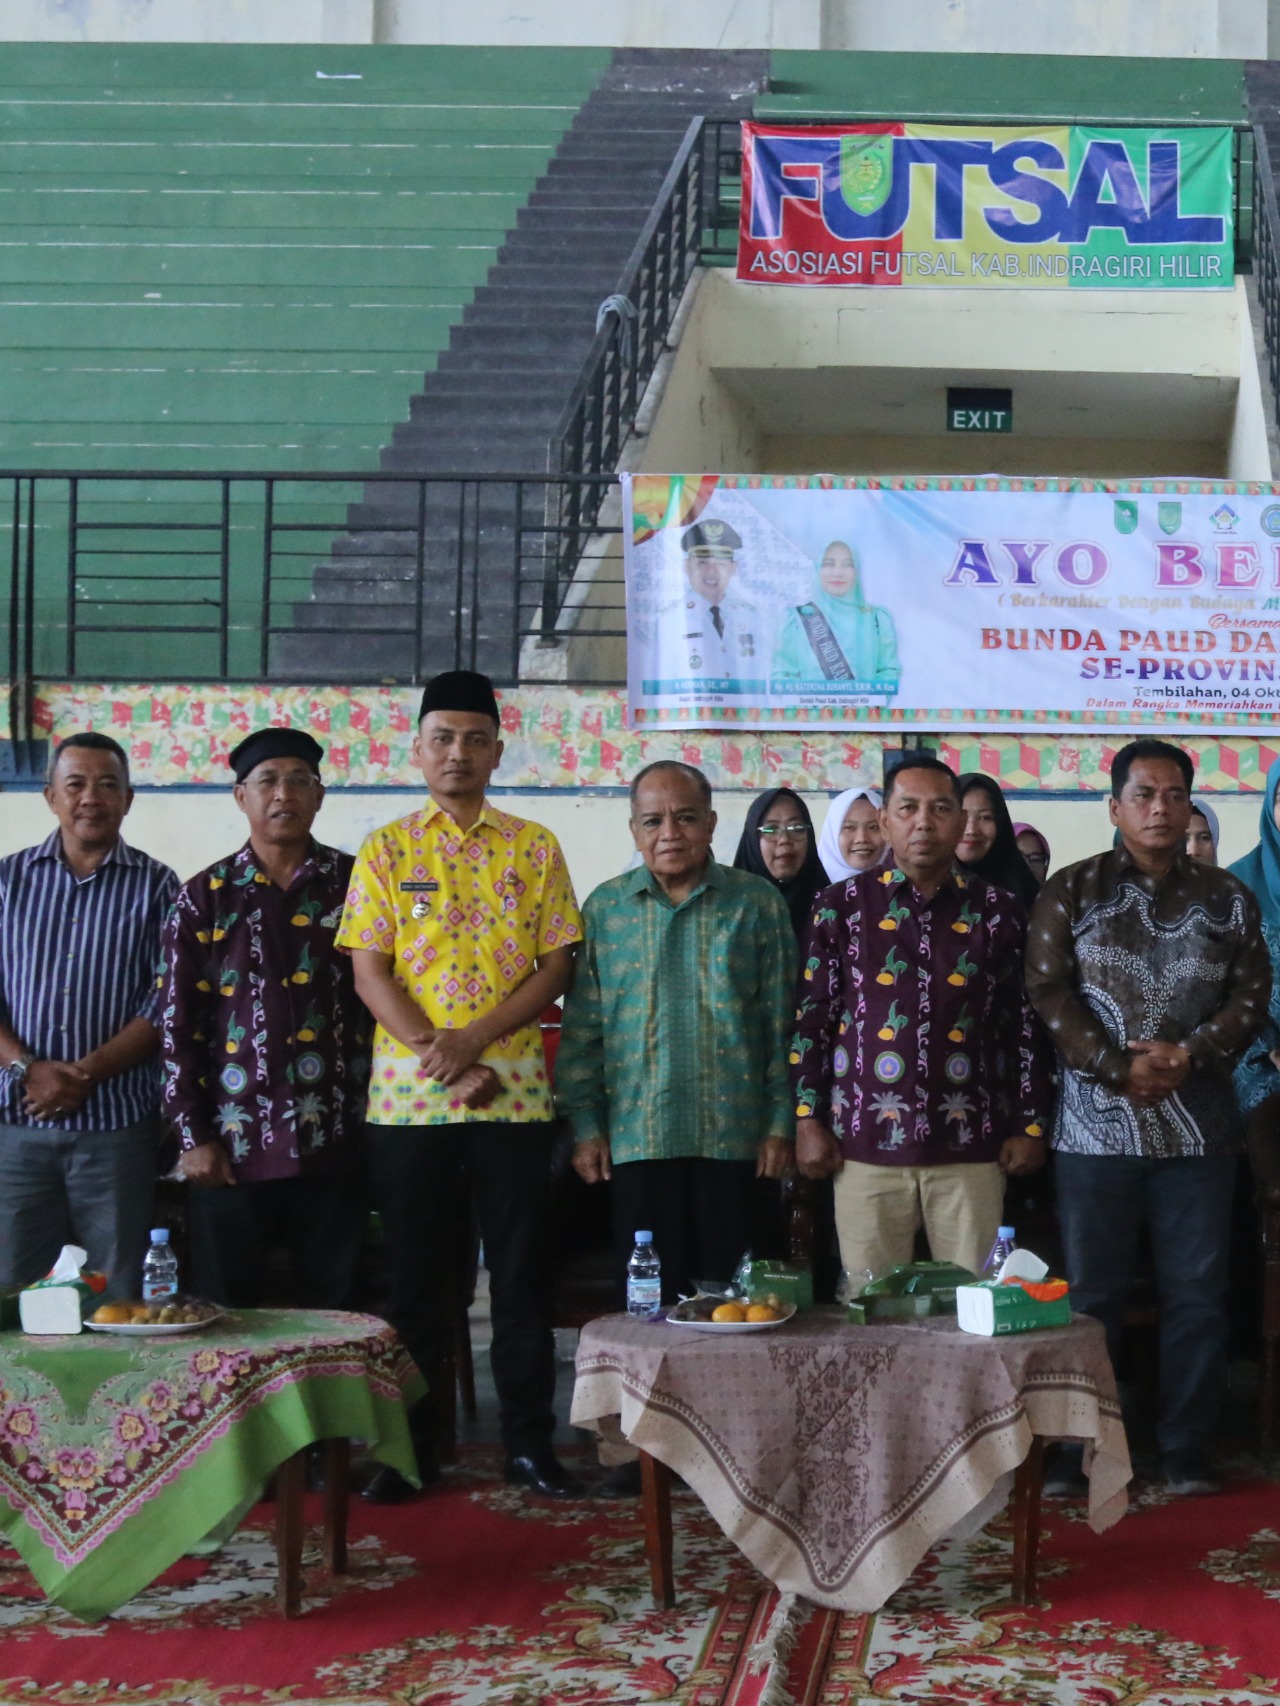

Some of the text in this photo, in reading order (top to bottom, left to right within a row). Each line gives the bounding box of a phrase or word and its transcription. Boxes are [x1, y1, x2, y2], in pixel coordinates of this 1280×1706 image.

[750, 133, 1226, 244] FUTSAL
[750, 249, 862, 276] ASOSIASI
[870, 251, 964, 278] FUTSAL
[1159, 255, 1223, 279] HILIR
[952, 410, 1006, 430] EXIT
[944, 539, 1111, 589] AYO
[1190, 595, 1255, 614] Budaya
[981, 628, 1107, 651] BUNDA
[1119, 629, 1217, 652] PAUD
[1133, 686, 1227, 698] Tembilahan,
[1231, 687, 1251, 697] 04
[1086, 698, 1127, 708] Dalam
[1132, 699, 1180, 711] Rangka
[1185, 699, 1273, 710] Memeriahkan
